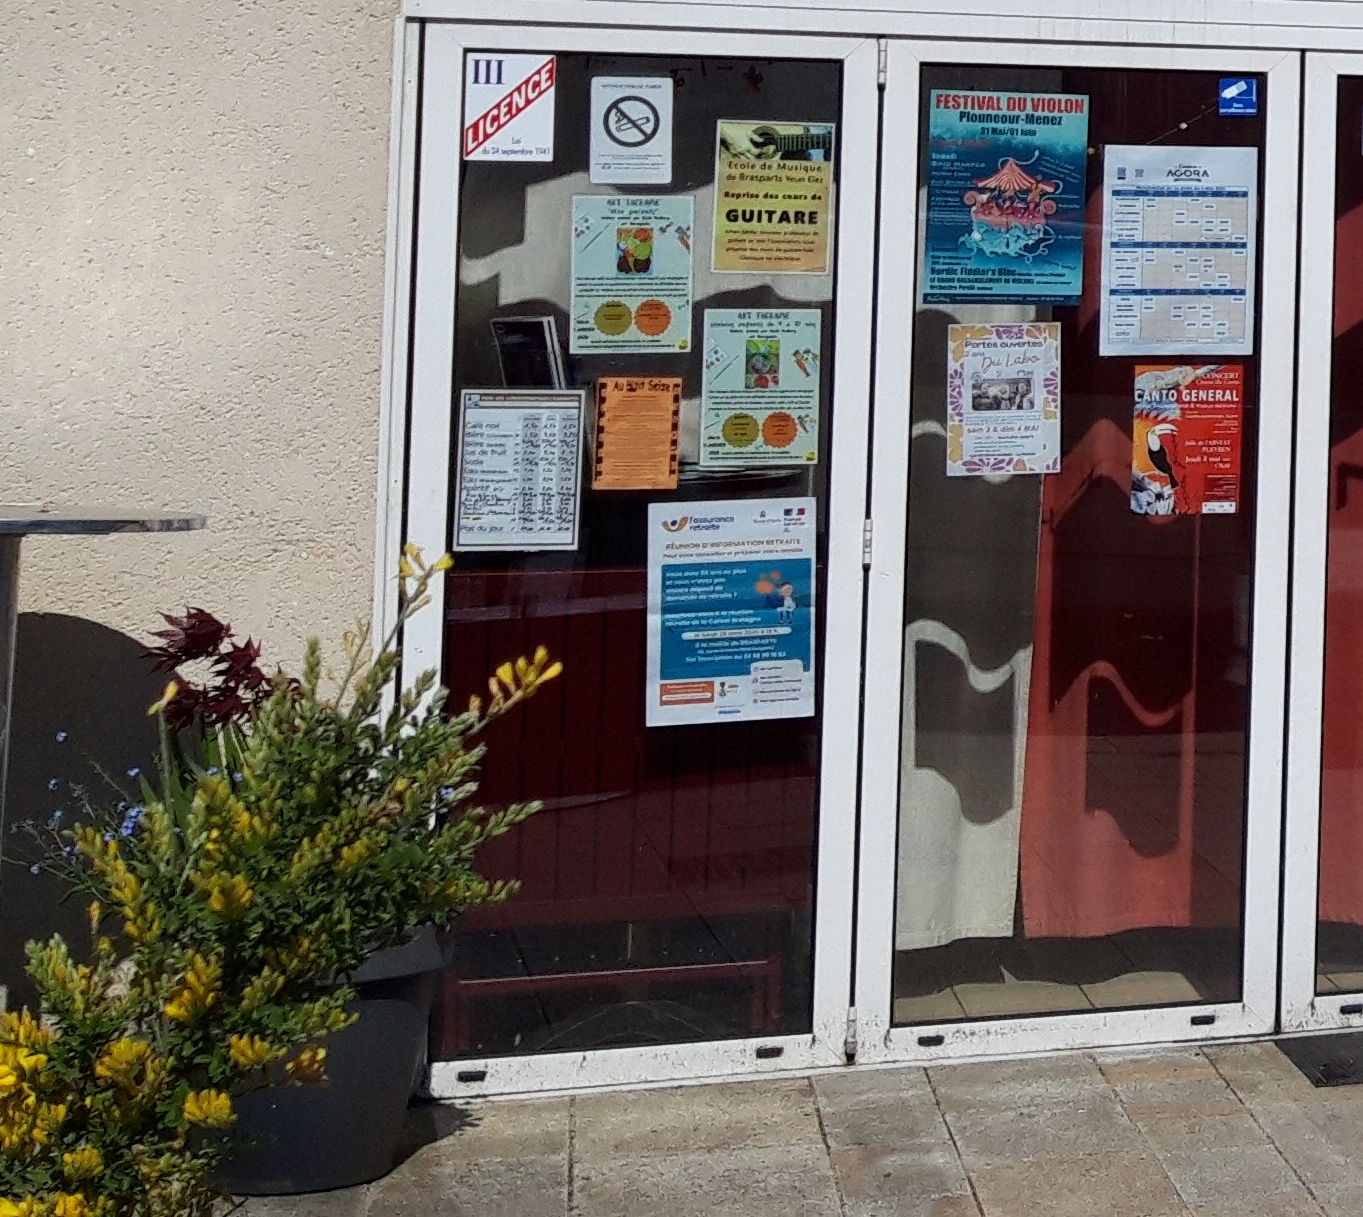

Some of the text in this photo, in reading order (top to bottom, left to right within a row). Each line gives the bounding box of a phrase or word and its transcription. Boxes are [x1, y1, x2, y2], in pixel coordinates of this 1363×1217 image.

[472, 59, 505, 85] III
[466, 61, 554, 154] LICENCE
[936, 94, 1084, 114] FESTIVAL DU VIOLON
[777, 162, 823, 173] Musique
[724, 191, 760, 200] Reprise
[725, 208, 818, 225] GUITARE
[1135, 389, 1240, 402] CANTO GENERAL
